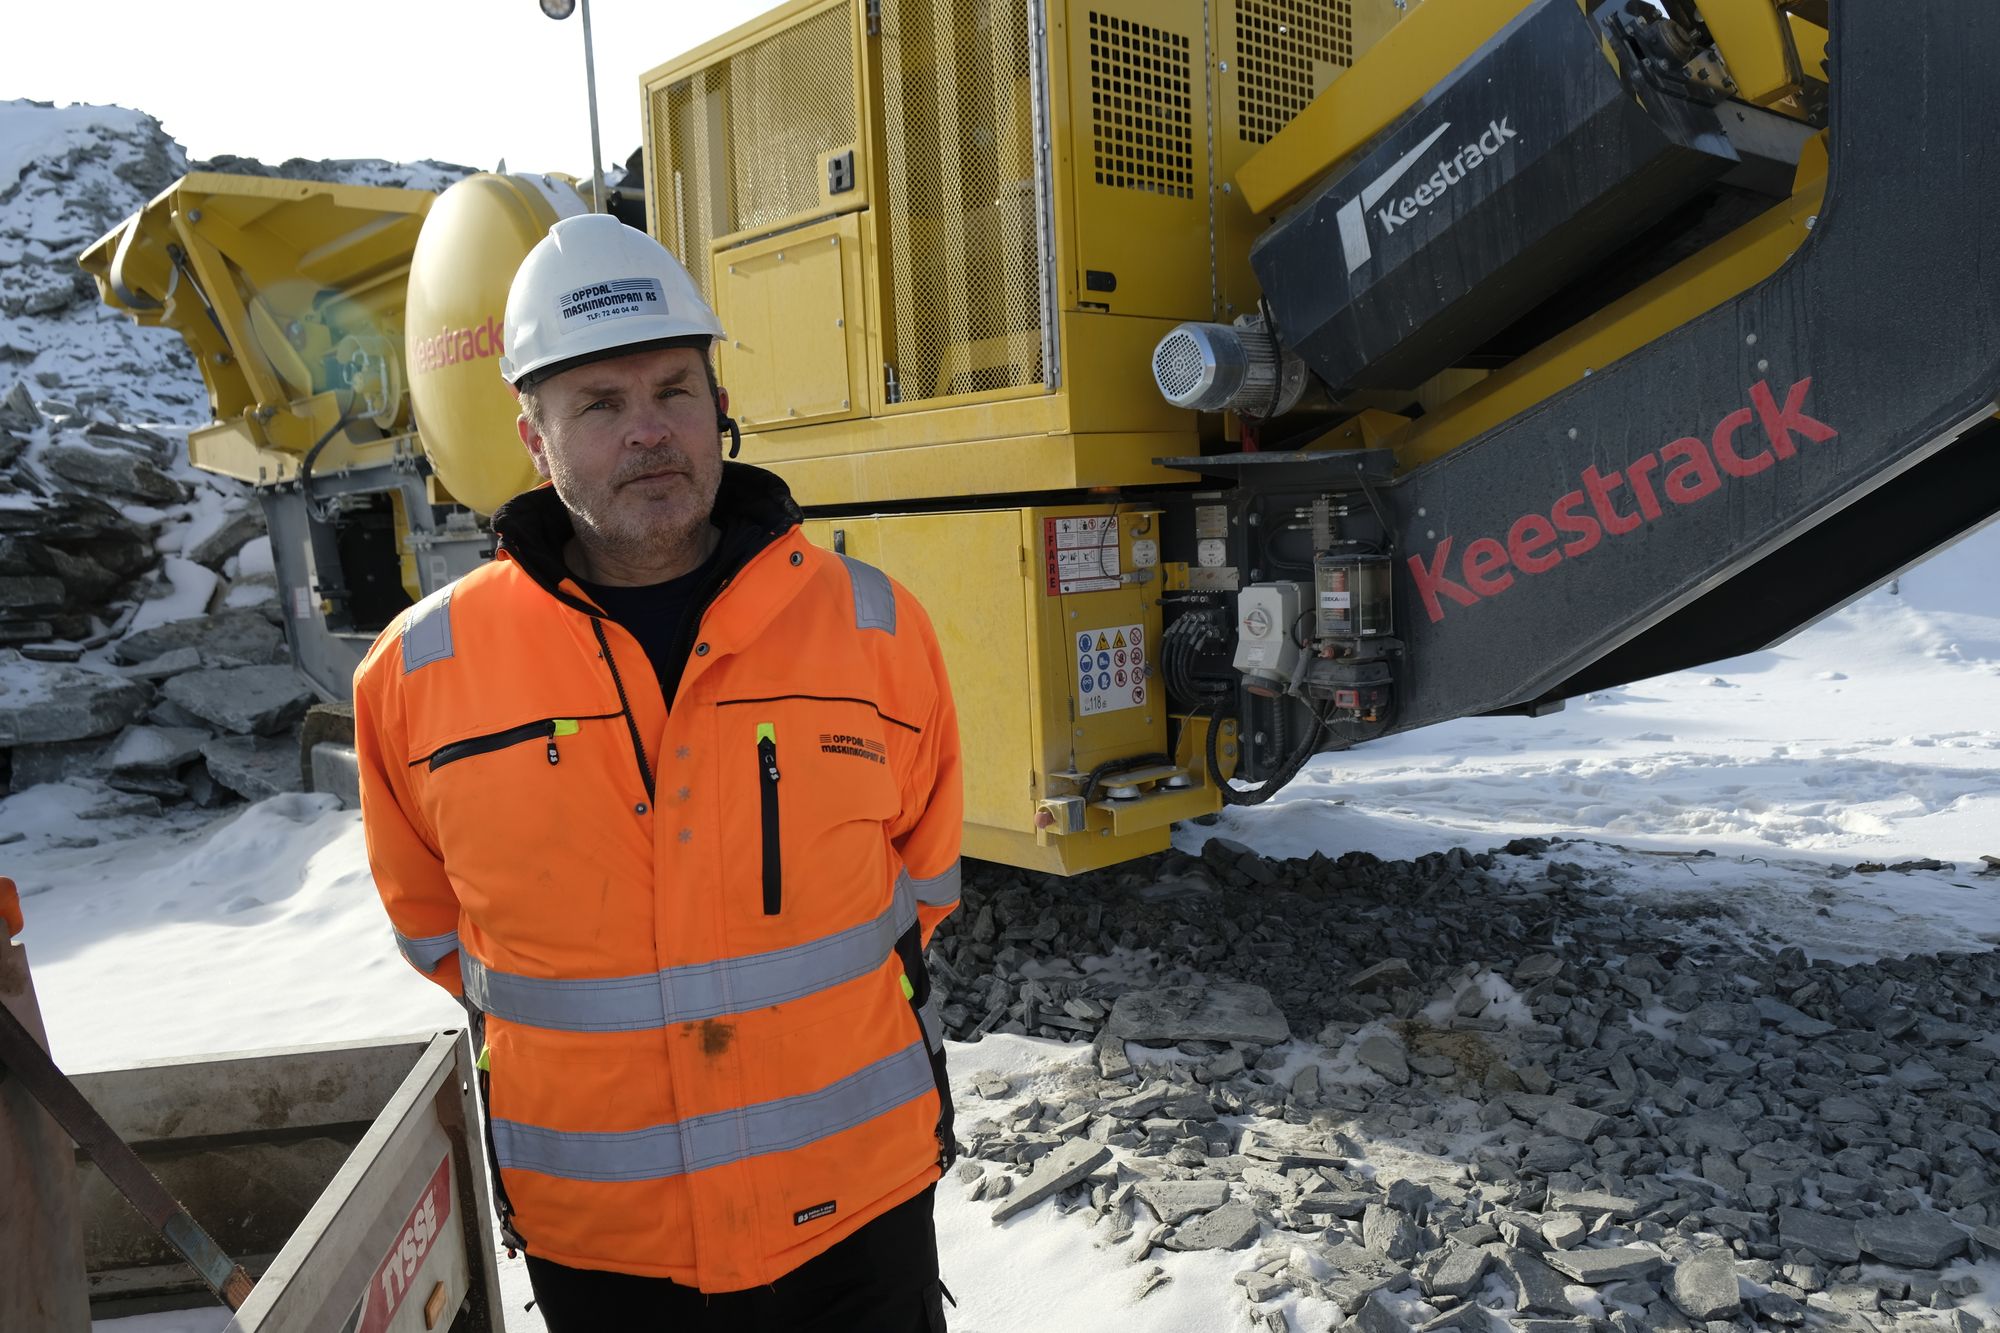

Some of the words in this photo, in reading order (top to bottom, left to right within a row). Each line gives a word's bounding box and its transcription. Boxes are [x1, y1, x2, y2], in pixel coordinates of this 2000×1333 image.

[1378, 116, 1518, 236] Keestrack
[562, 291, 643, 319] MASKINKOMPANI
[645, 291, 657, 302] AS
[572, 284, 612, 302] OPPDAL
[586, 312, 601, 321] TLF:
[1407, 376, 1838, 624] Keestrack
[833, 735, 864, 747] OPPDAL
[381, 1189, 437, 1314] TYSSE
